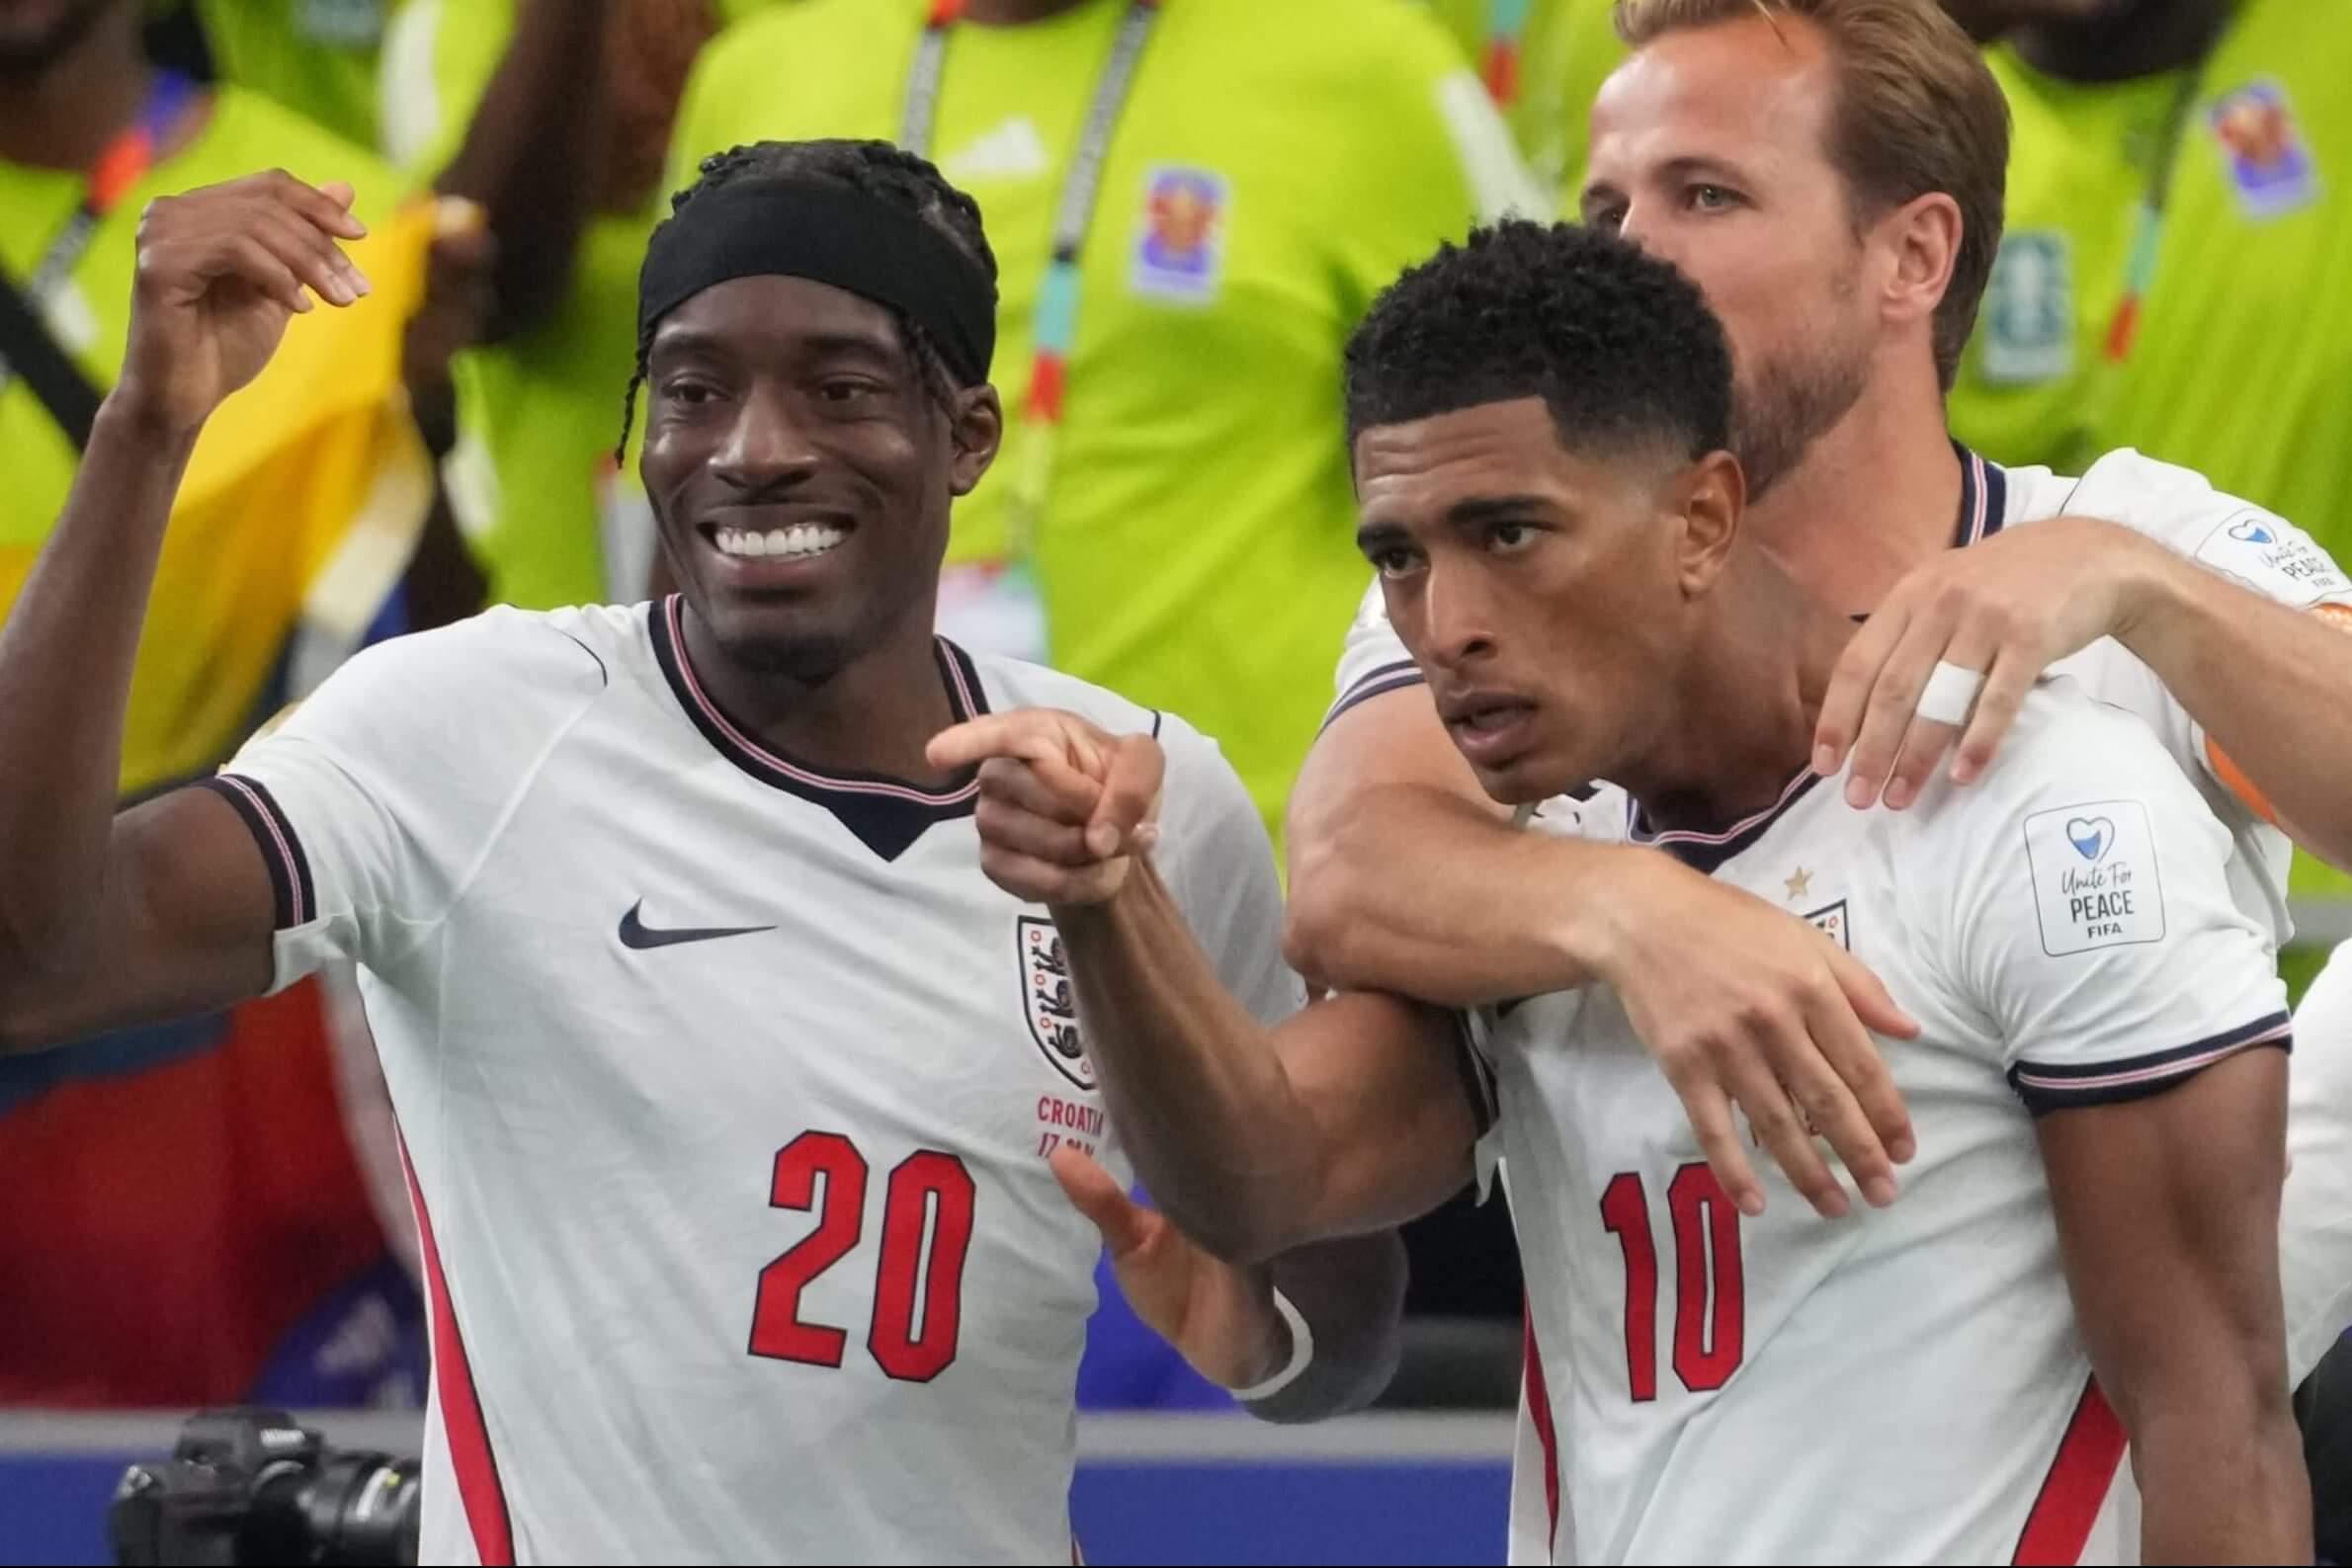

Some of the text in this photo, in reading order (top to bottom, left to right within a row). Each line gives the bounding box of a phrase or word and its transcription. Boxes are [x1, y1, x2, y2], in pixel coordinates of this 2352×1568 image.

[2060, 861, 2133, 896] Unite For
[2069, 889, 2136, 924] PEACE
[2087, 922, 2124, 939] FIFA
[747, 1129, 976, 1383] 20
[1599, 1161, 1745, 1403] 10
